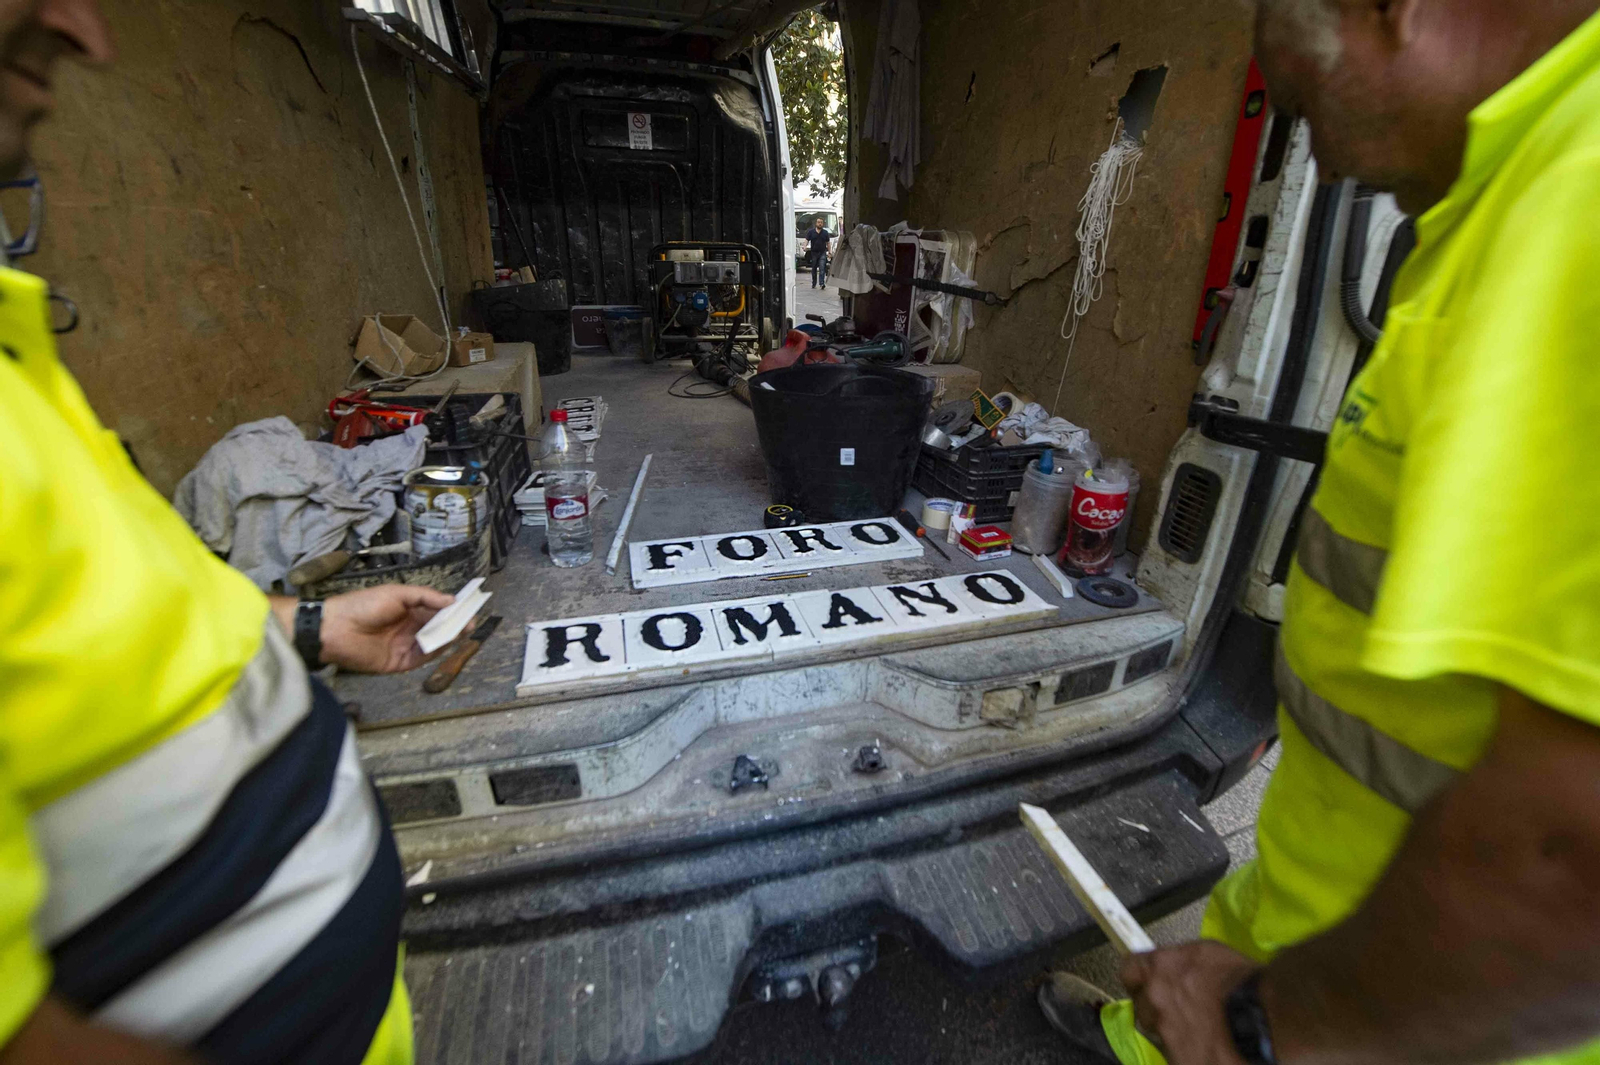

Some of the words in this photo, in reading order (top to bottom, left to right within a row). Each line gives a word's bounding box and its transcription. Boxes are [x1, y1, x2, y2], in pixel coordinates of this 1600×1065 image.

[1077, 497, 1124, 520] Cacao
[646, 522, 901, 570] FORO
[538, 572, 1026, 668] ROMANO
